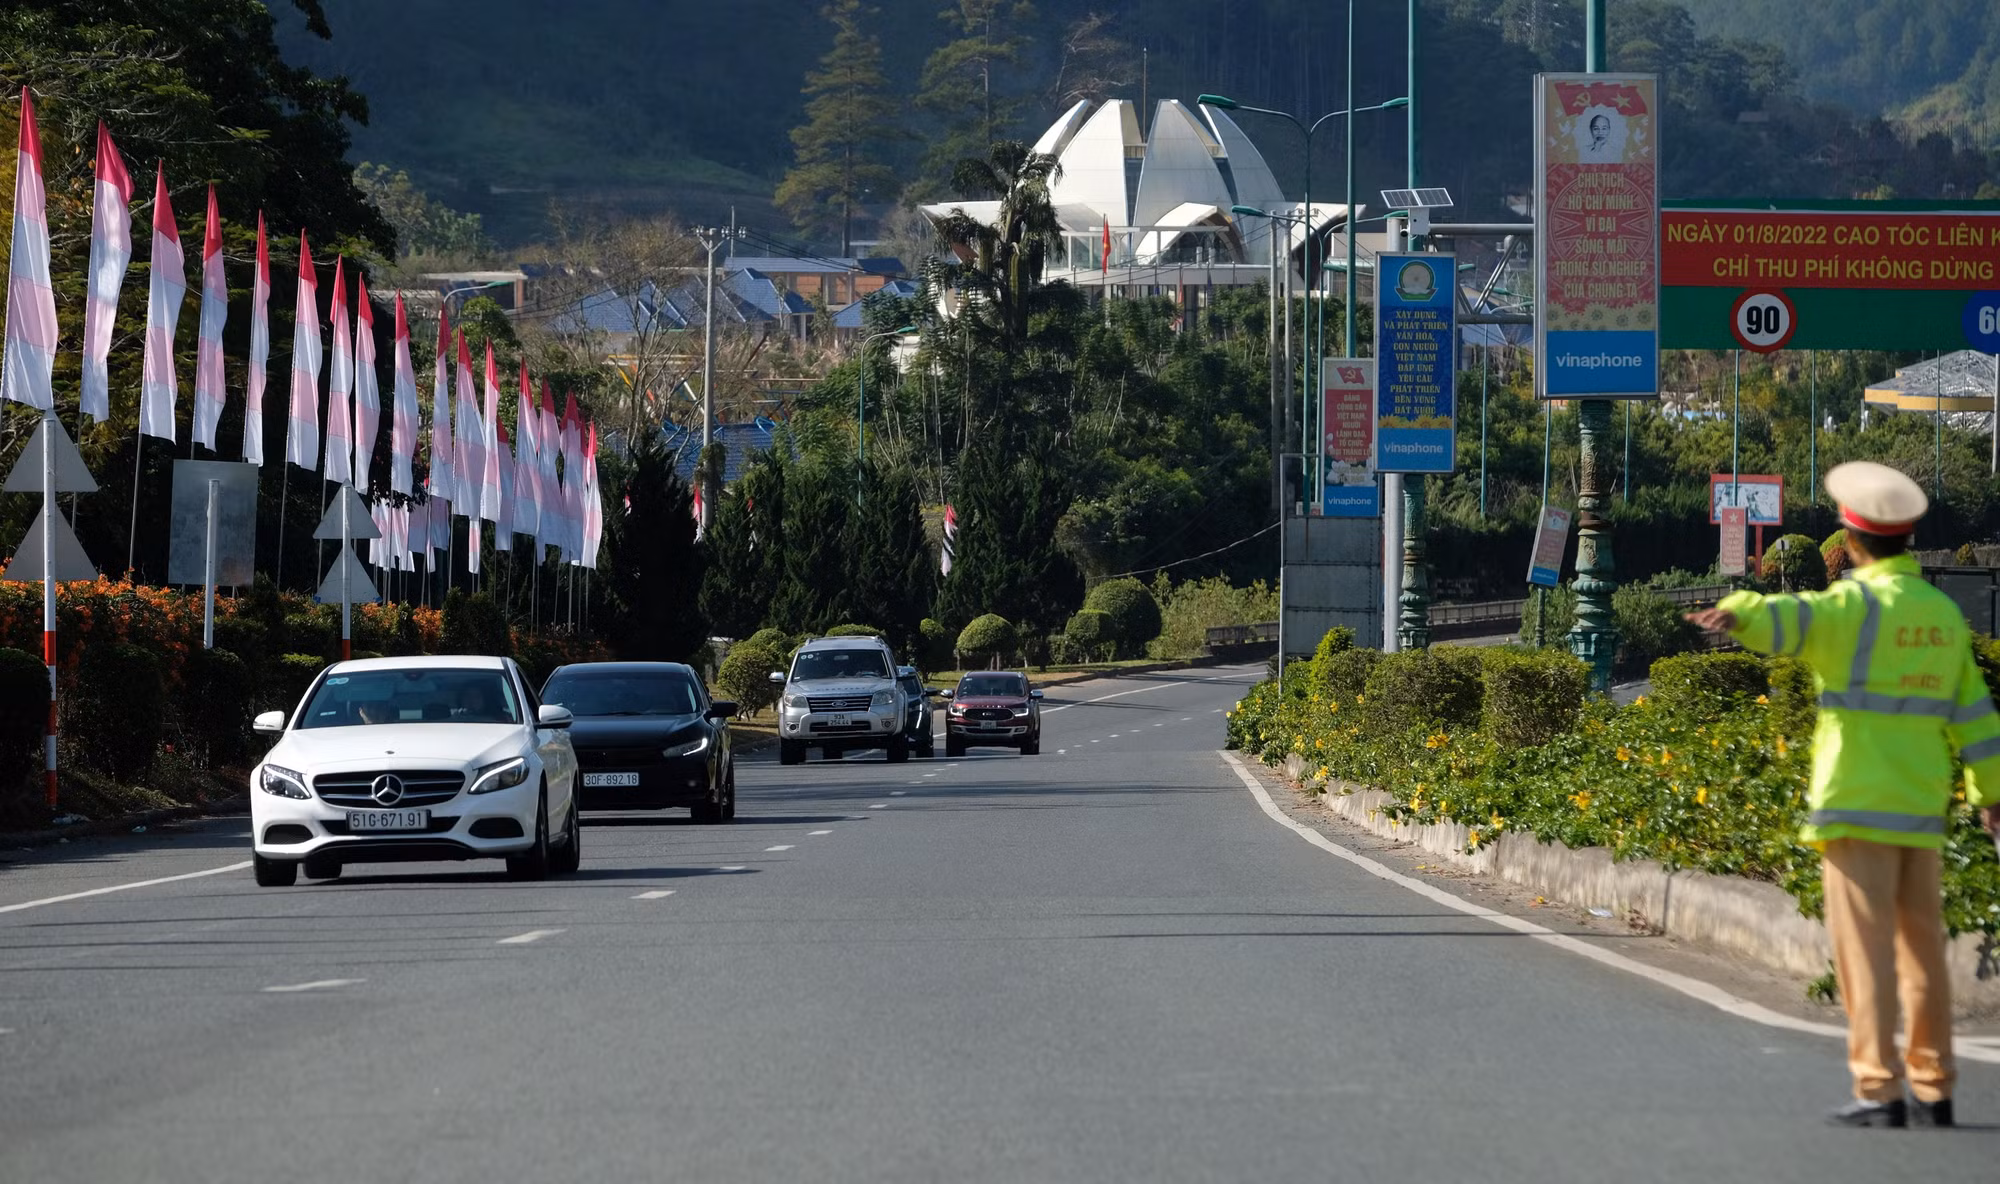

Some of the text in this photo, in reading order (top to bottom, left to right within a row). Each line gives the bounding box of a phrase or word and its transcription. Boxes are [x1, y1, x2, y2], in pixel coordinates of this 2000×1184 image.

[1606, 195, 1633, 209] MINH
[1667, 218, 1728, 243] NGÀY
[1733, 224, 1827, 244] 01/8/2022
[1833, 225, 1880, 245] CAO
[1886, 222, 1930, 246] TỐC
[1937, 222, 1983, 246] LIÊN
[1555, 261, 1589, 276] TRONG
[1713, 253, 1994, 280] CHỈ THU PHÍ KHÔNG DỪNG
[1624, 283, 1638, 298] TA
[1746, 305, 1780, 335] 90
[1979, 305, 2000, 335] 6
[1417, 353, 1436, 361] NAM
[1556, 352, 1642, 370] vinaphone
[1384, 441, 1443, 455] vinaphone
[1328, 496, 1372, 506] vinaphone
[585, 774, 638, 786] 30F-892.18
[352, 811, 422, 828] 51G-671.91
